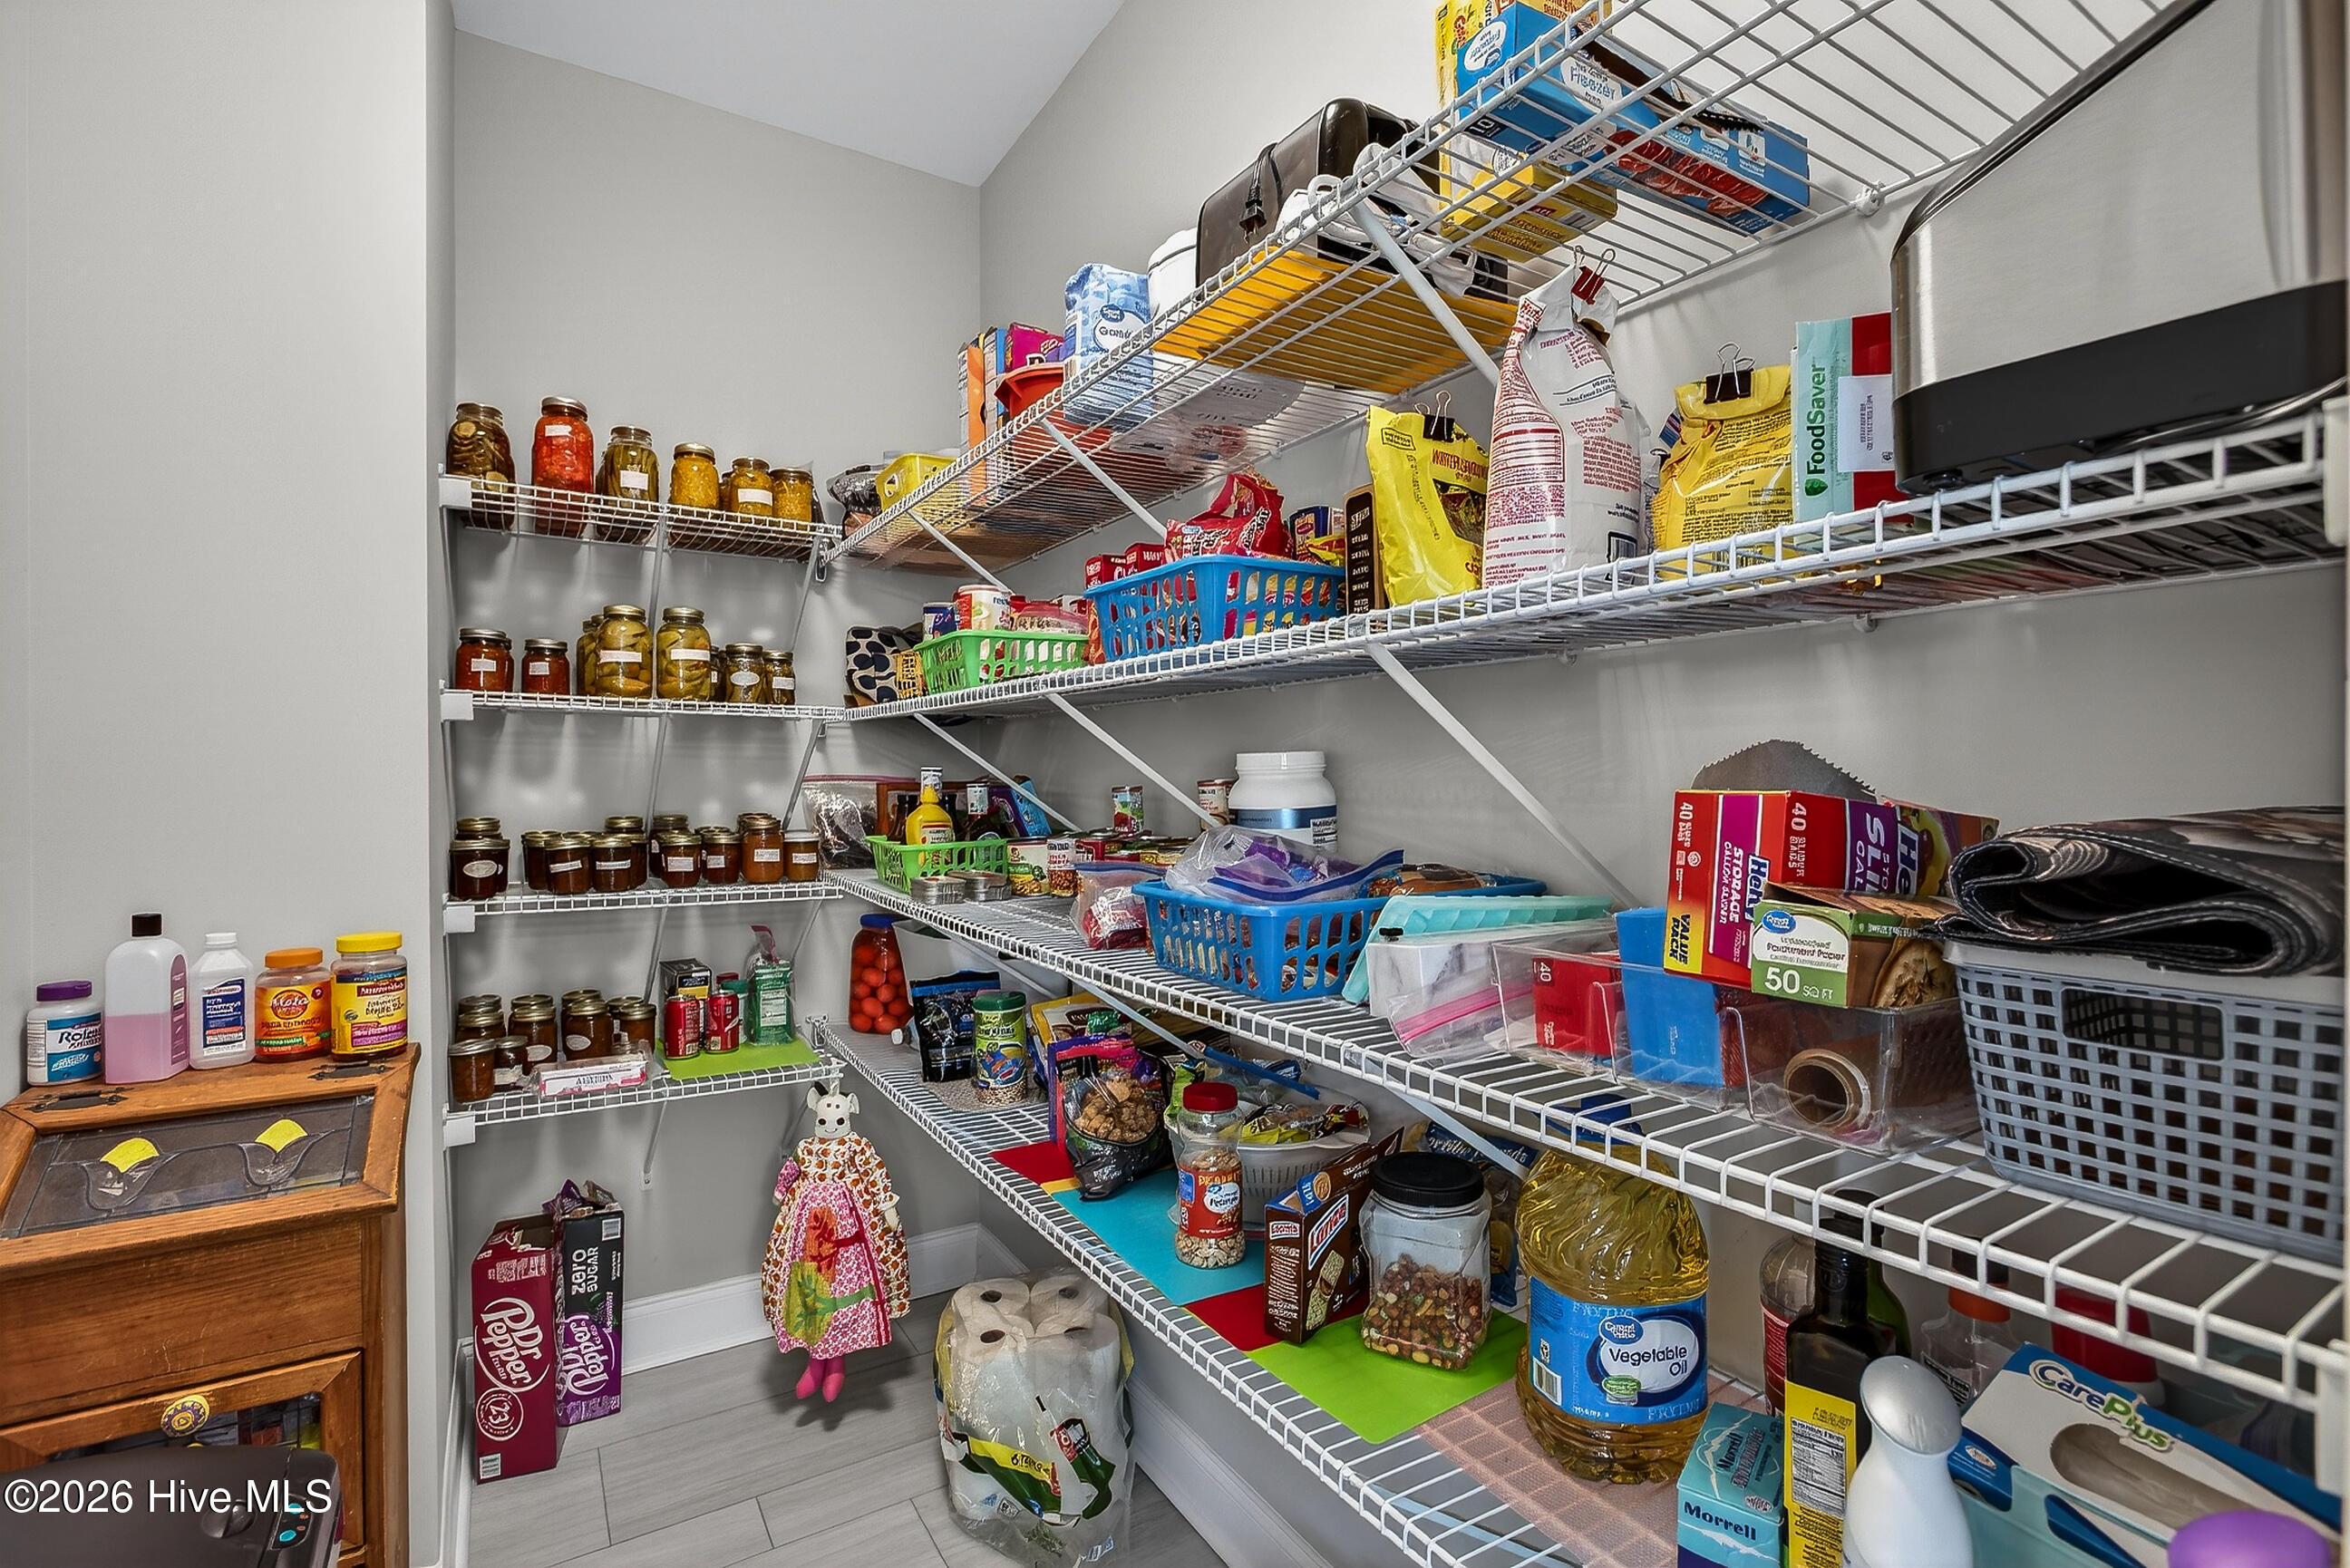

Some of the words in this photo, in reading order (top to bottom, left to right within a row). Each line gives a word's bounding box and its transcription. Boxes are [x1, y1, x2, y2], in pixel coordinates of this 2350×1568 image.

[1807, 364, 1826, 474] FoodSaver
[1679, 802, 1694, 819] 40
[1791, 802, 1807, 831] 40
[1729, 846, 1744, 924] STORAGE
[1669, 916, 1681, 961] PACK
[1678, 913, 1692, 965] VALUE
[1540, 962, 1553, 982] 40
[1764, 966, 1801, 994] 50
[1802, 985, 1820, 998] SQ
[1821, 988, 1833, 1001] FT
[587, 1246, 599, 1293] SUGAR
[566, 1321, 610, 1390] Pepper
[1608, 1345, 1688, 1367] Vegetable
[1669, 1360, 1688, 1377] Oil
[490, 1401, 510, 1425] 23
[1683, 1500, 1757, 1541] Morrell
